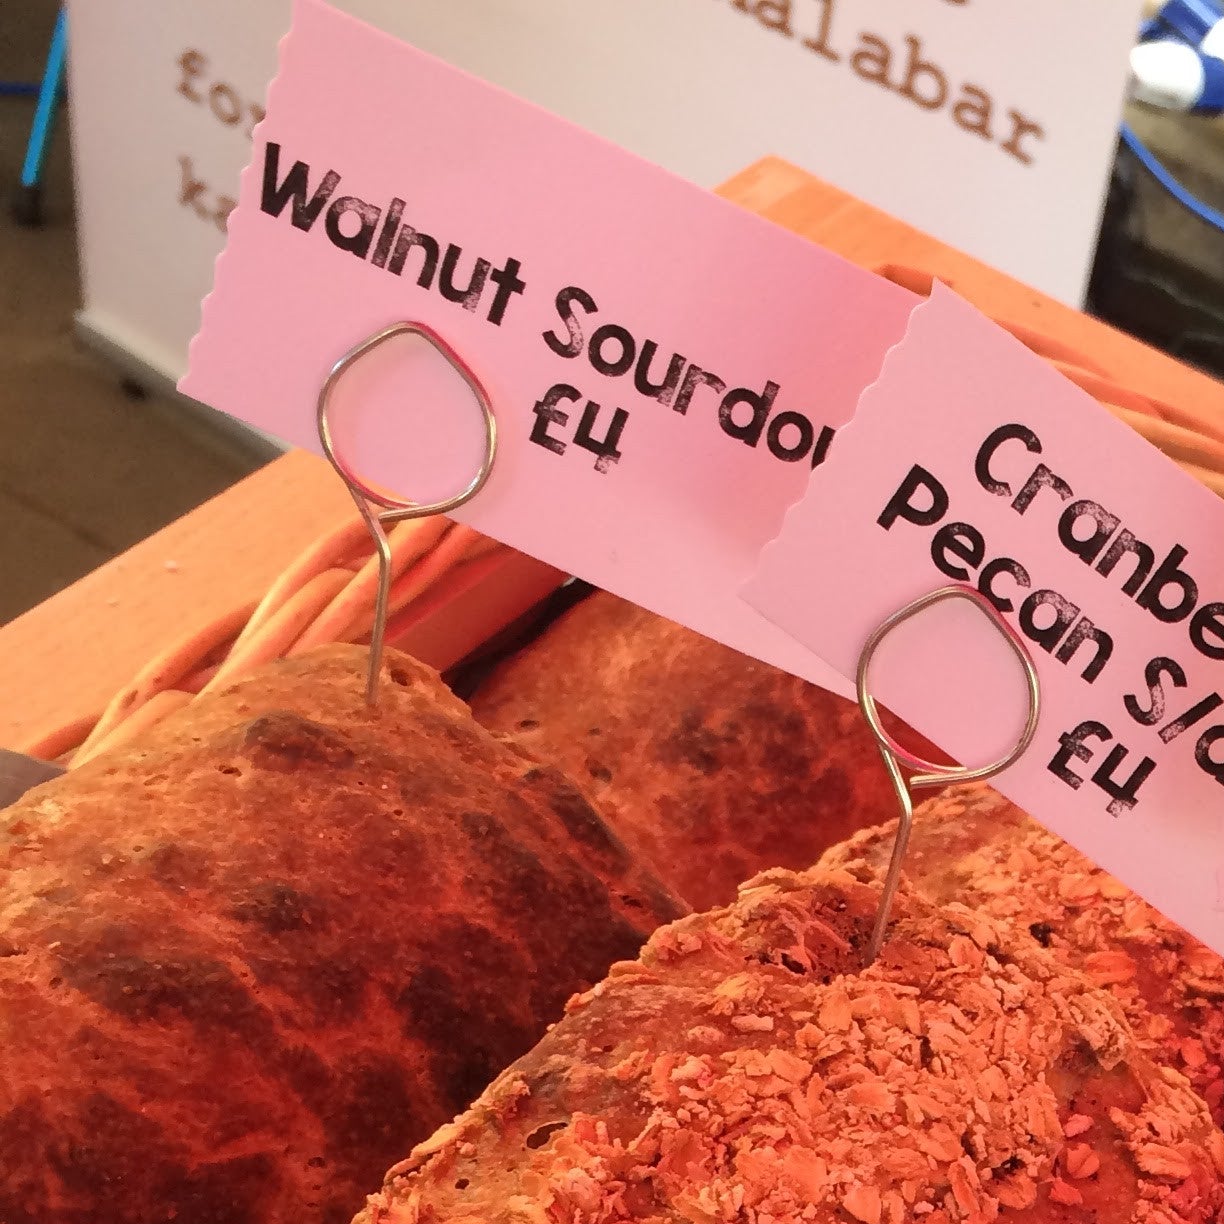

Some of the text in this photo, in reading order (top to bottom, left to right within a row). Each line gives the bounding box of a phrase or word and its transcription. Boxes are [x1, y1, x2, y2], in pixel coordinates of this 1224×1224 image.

[728, 0, 1044, 165] alabar
[260, 141, 526, 327] Walnut
[528, 384, 630, 475] £4
[876, 463, 1114, 684] Pecan
[1046, 720, 1157, 819] £4
